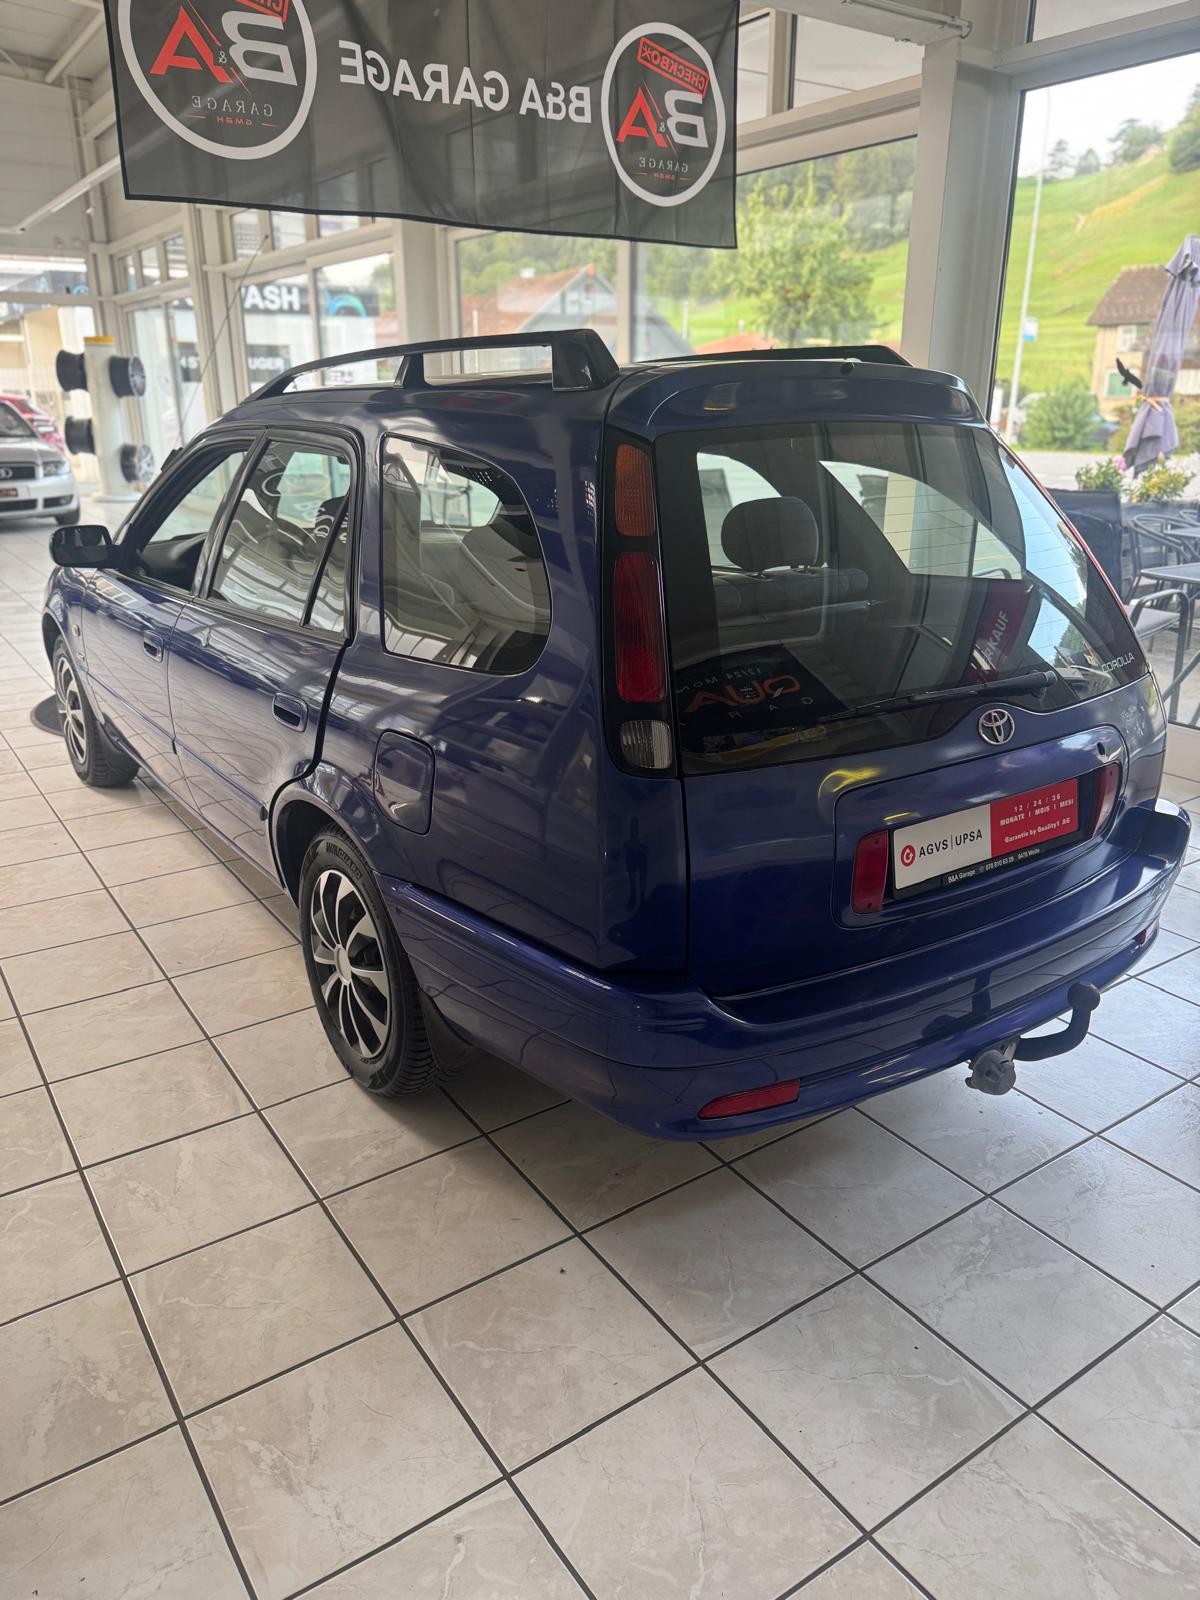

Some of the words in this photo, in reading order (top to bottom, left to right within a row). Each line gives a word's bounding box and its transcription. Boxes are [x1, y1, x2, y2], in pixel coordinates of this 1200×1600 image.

[241, 285, 300, 311] ASH
[1101, 652, 1135, 673] COROLLA
[918, 838, 949, 858] AGVS
[955, 828, 983, 847] UPSA
